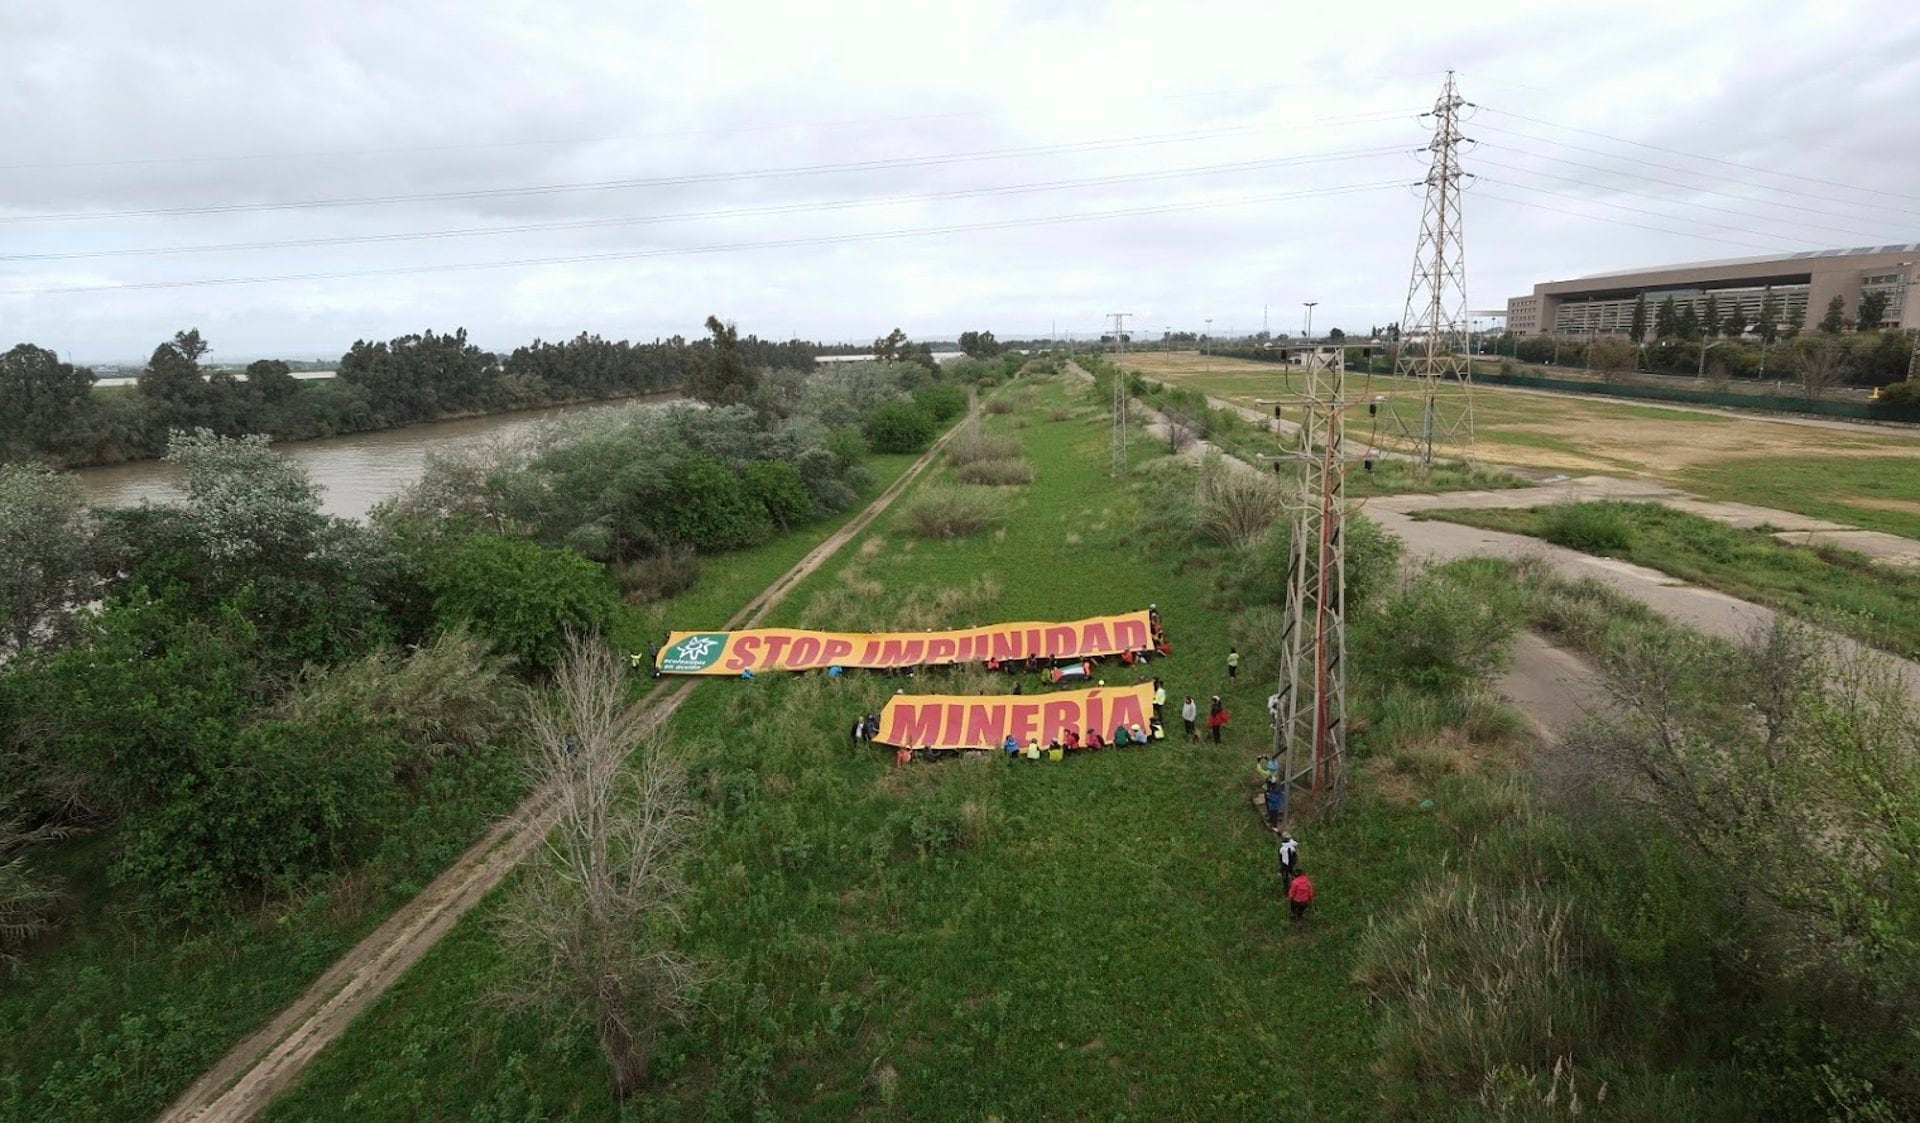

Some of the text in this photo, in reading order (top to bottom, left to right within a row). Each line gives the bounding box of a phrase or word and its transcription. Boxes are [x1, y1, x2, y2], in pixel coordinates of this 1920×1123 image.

[726, 619, 1147, 670] STOP IMPUNIDAD
[888, 690, 1147, 747] MINERÍA
